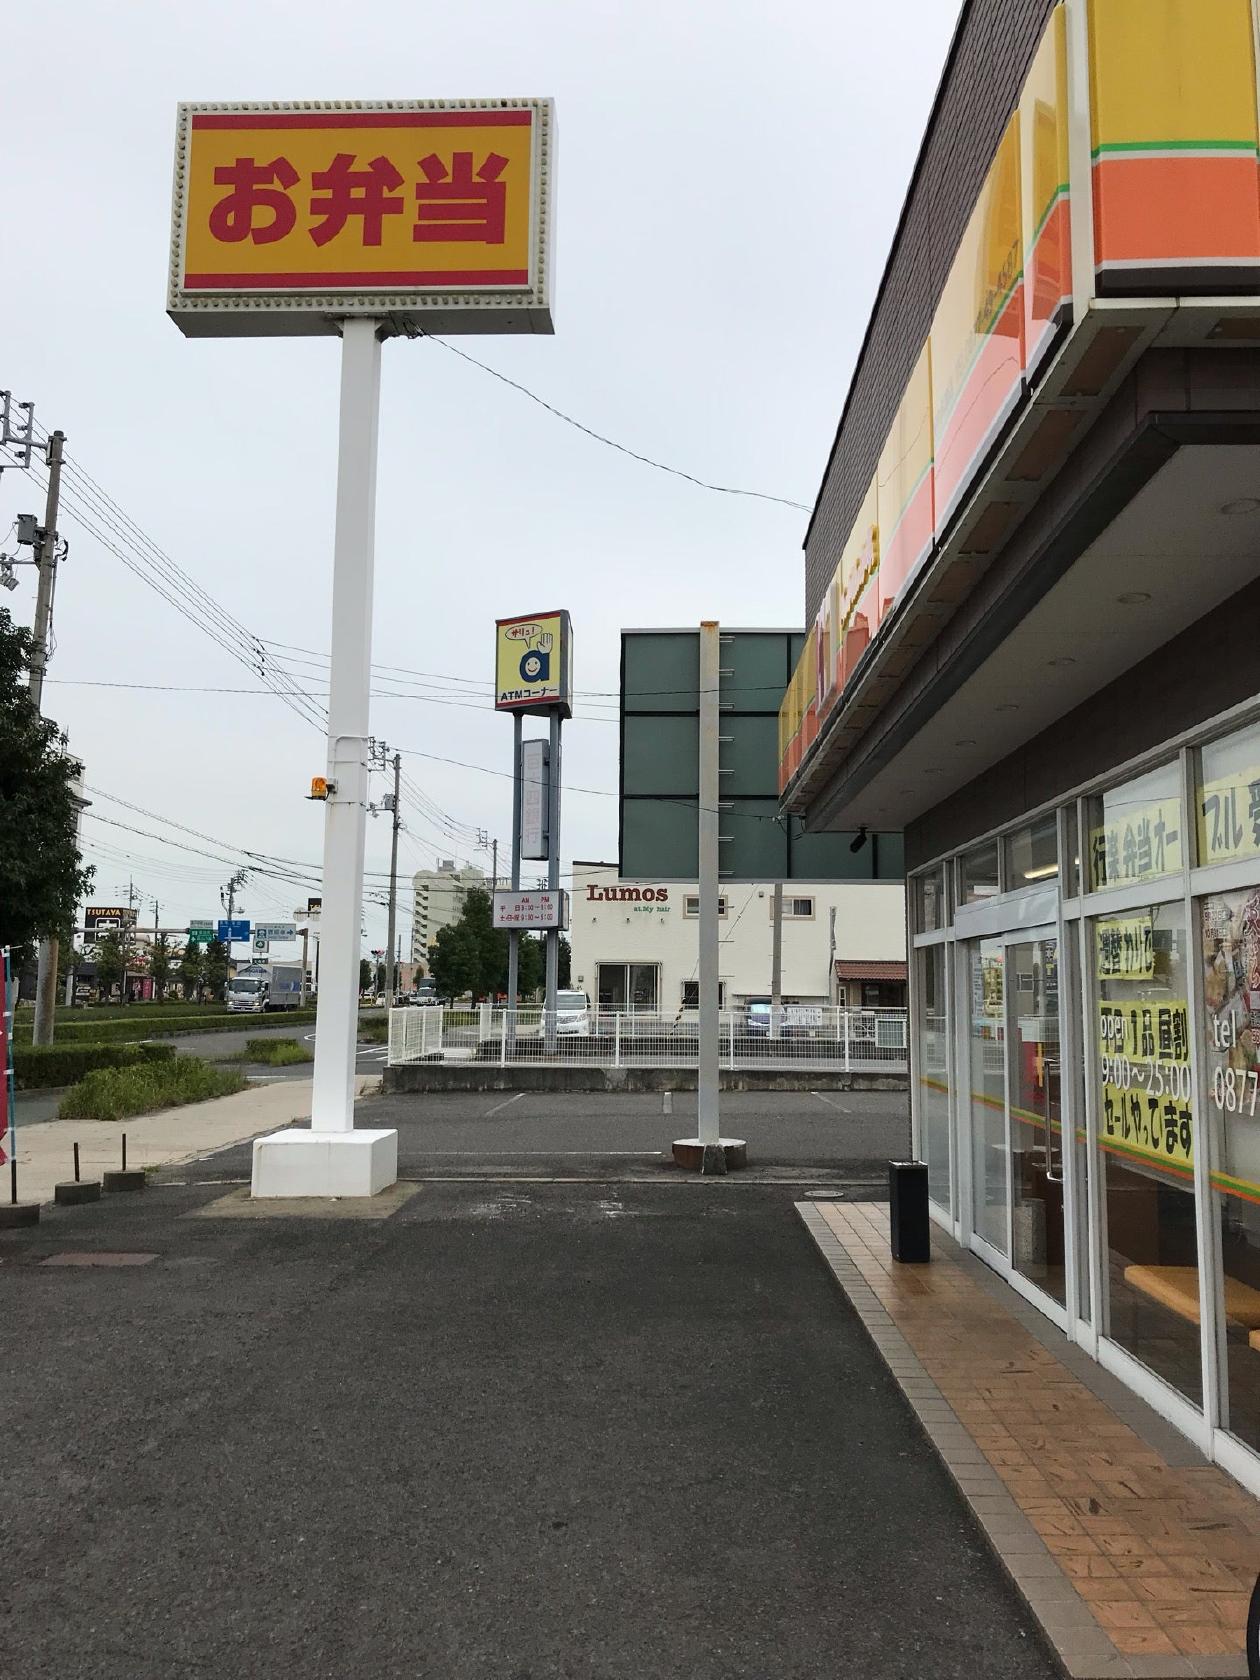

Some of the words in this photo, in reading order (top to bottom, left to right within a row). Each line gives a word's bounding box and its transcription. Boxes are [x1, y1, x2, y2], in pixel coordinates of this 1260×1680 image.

[209, 152, 509, 248] お弁当
[501, 686, 558, 701] ATMコーナー
[586, 884, 669, 902] Lumos
[1100, 1013, 1129, 1040] open
[1213, 1009, 1237, 1049] tel
[1215, 1065, 1259, 1117] 0877
